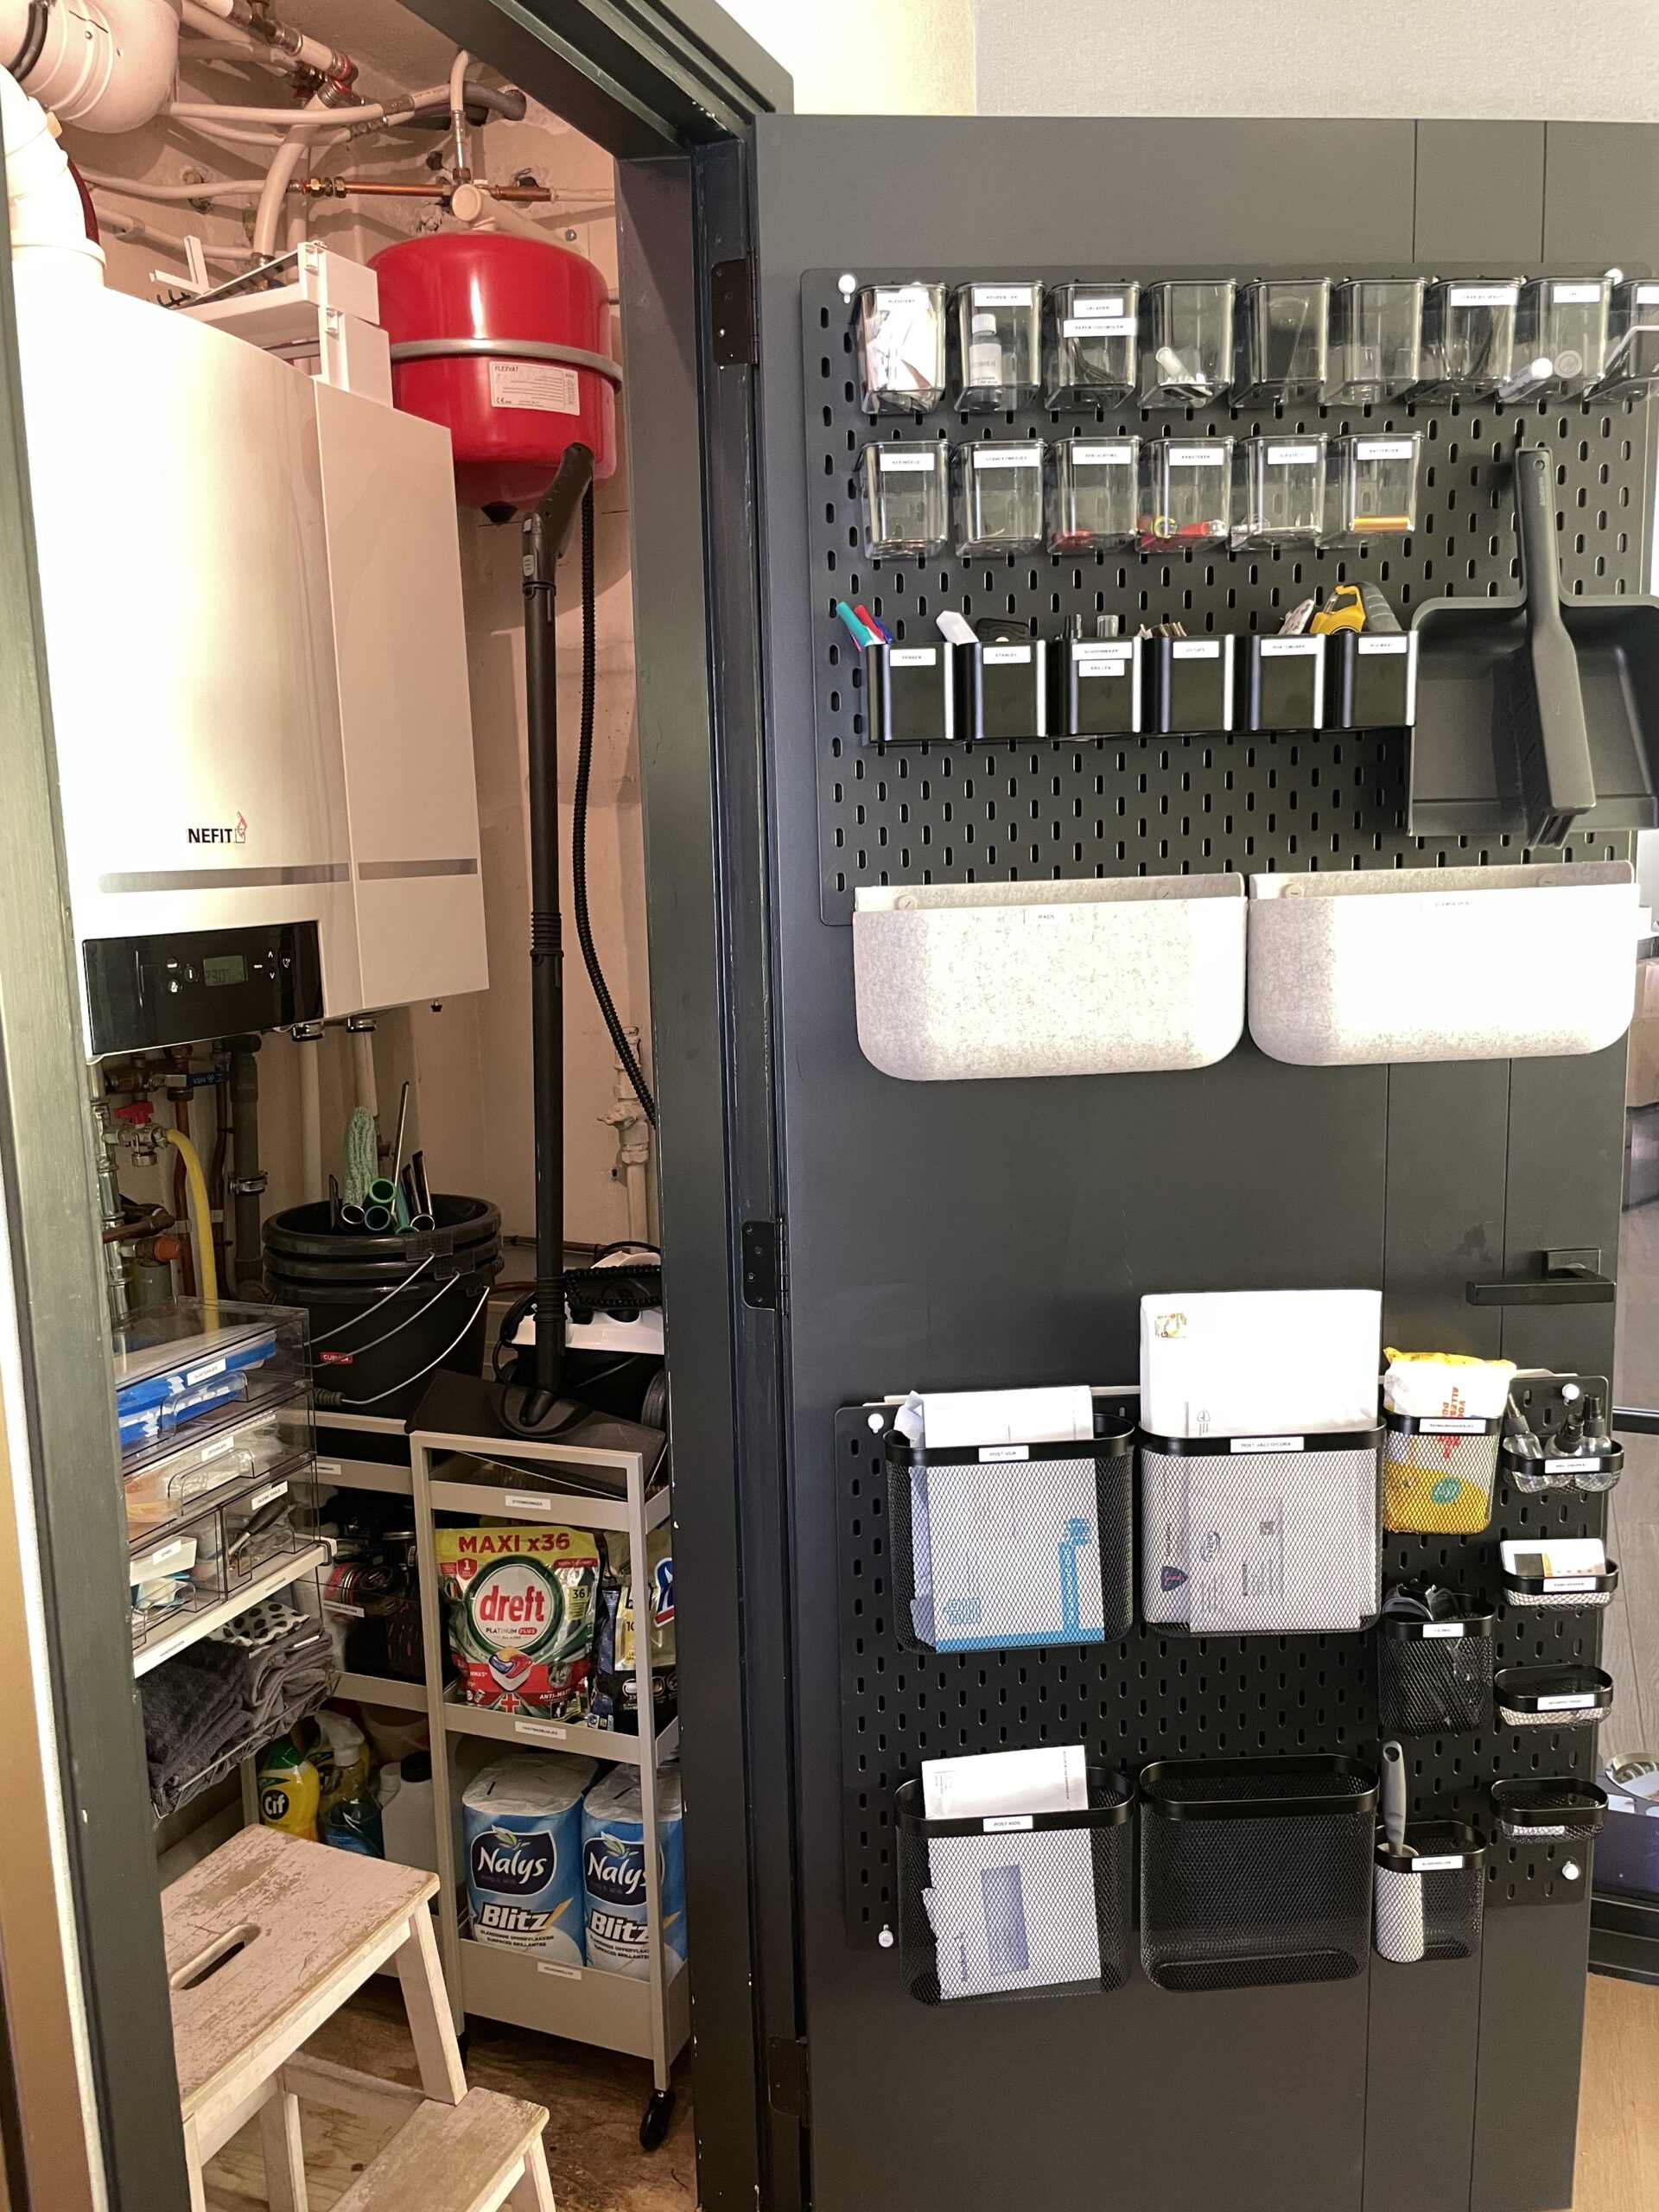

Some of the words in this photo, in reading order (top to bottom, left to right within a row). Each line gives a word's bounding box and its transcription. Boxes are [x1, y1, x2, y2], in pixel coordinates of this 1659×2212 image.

[188, 829, 232, 843] NEFIT
[1450, 1386, 1459, 1418] ALLES
[458, 1535, 520, 1554] MAXI
[527, 1533, 571, 1552] x36
[464, 1559, 471, 1570] 1
[480, 1586, 544, 1622] dreft
[573, 1589, 585, 1599] 36
[264, 1794, 285, 1815] Cif
[478, 1847, 547, 1884] Nalys
[482, 1904, 550, 1930] Blitz
